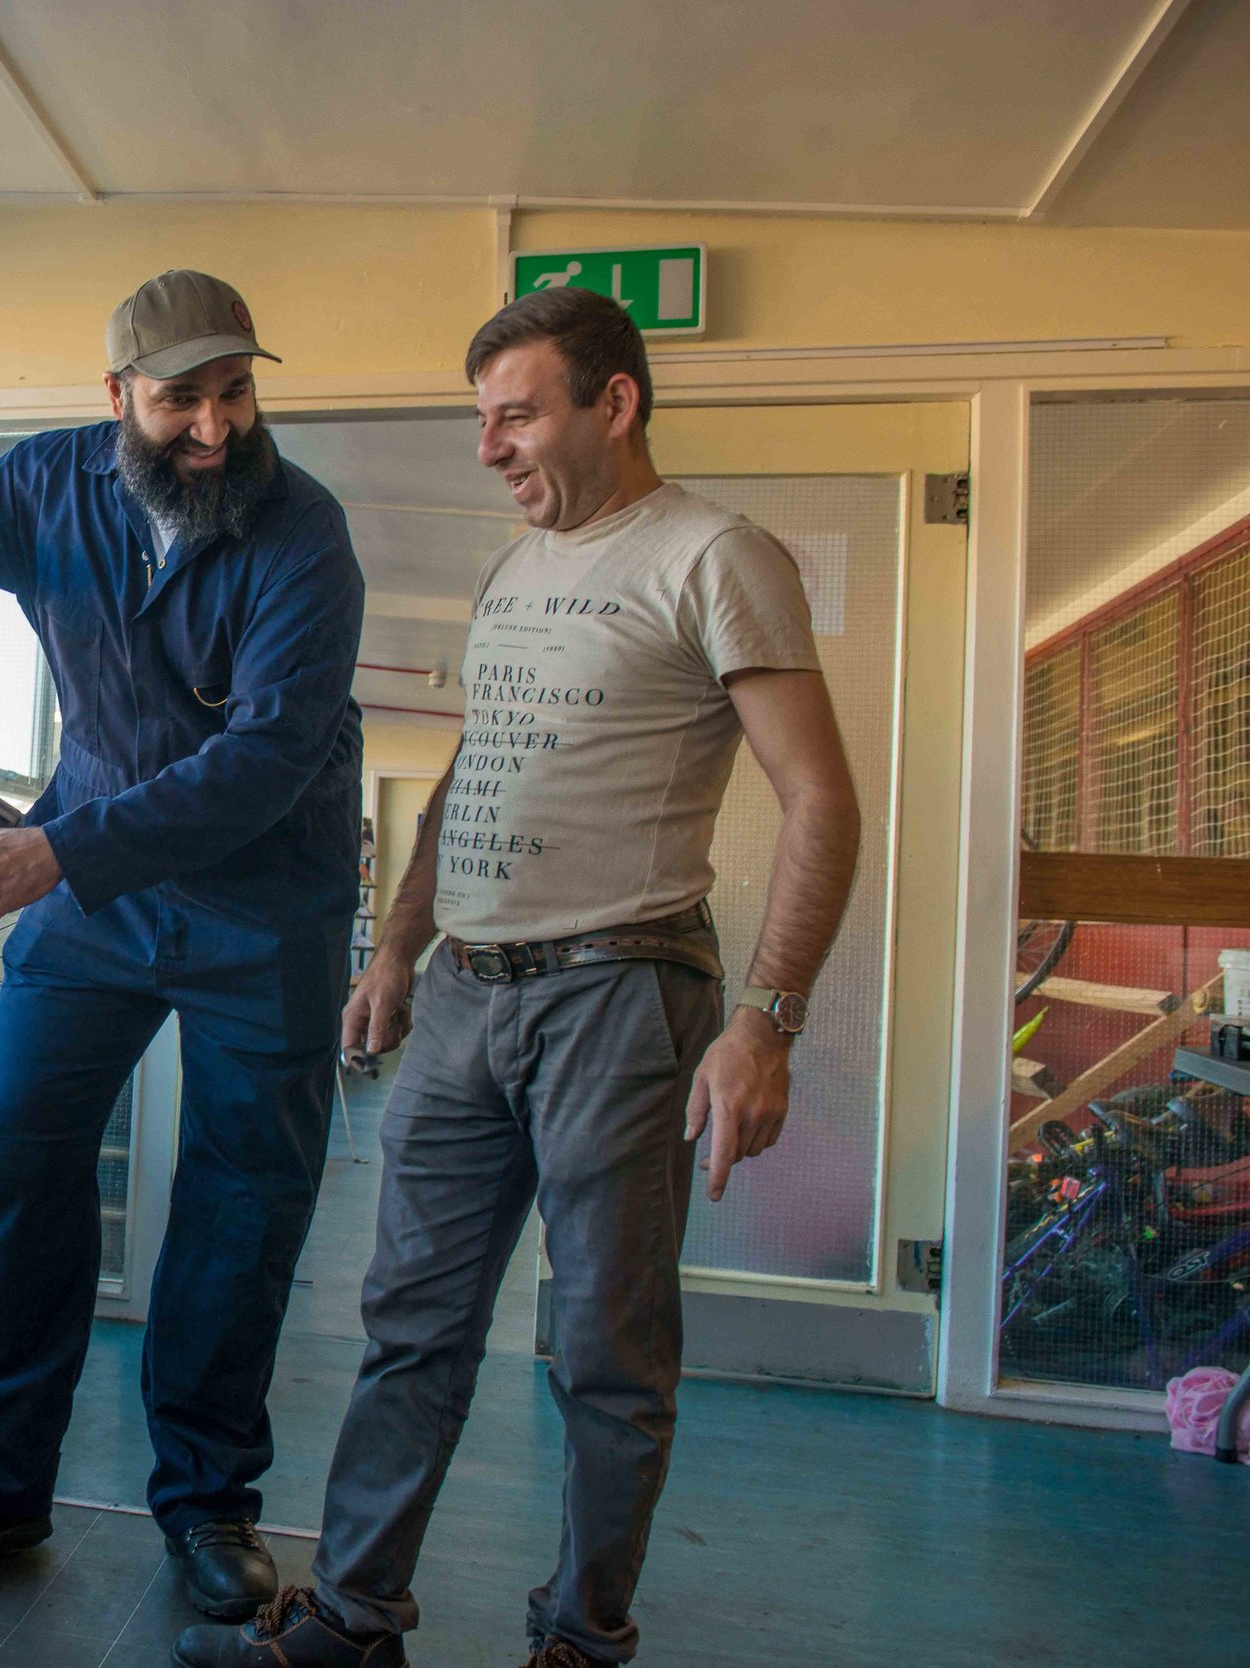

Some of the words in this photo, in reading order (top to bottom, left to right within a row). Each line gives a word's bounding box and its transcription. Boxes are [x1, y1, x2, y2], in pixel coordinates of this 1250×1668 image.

[545, 597, 621, 615] WILD
[478, 663, 537, 684] PARIS
[472, 683, 605, 706] FRANCISCO
[471, 708, 536, 727] TOKYO
[450, 855, 513, 880] YORK
